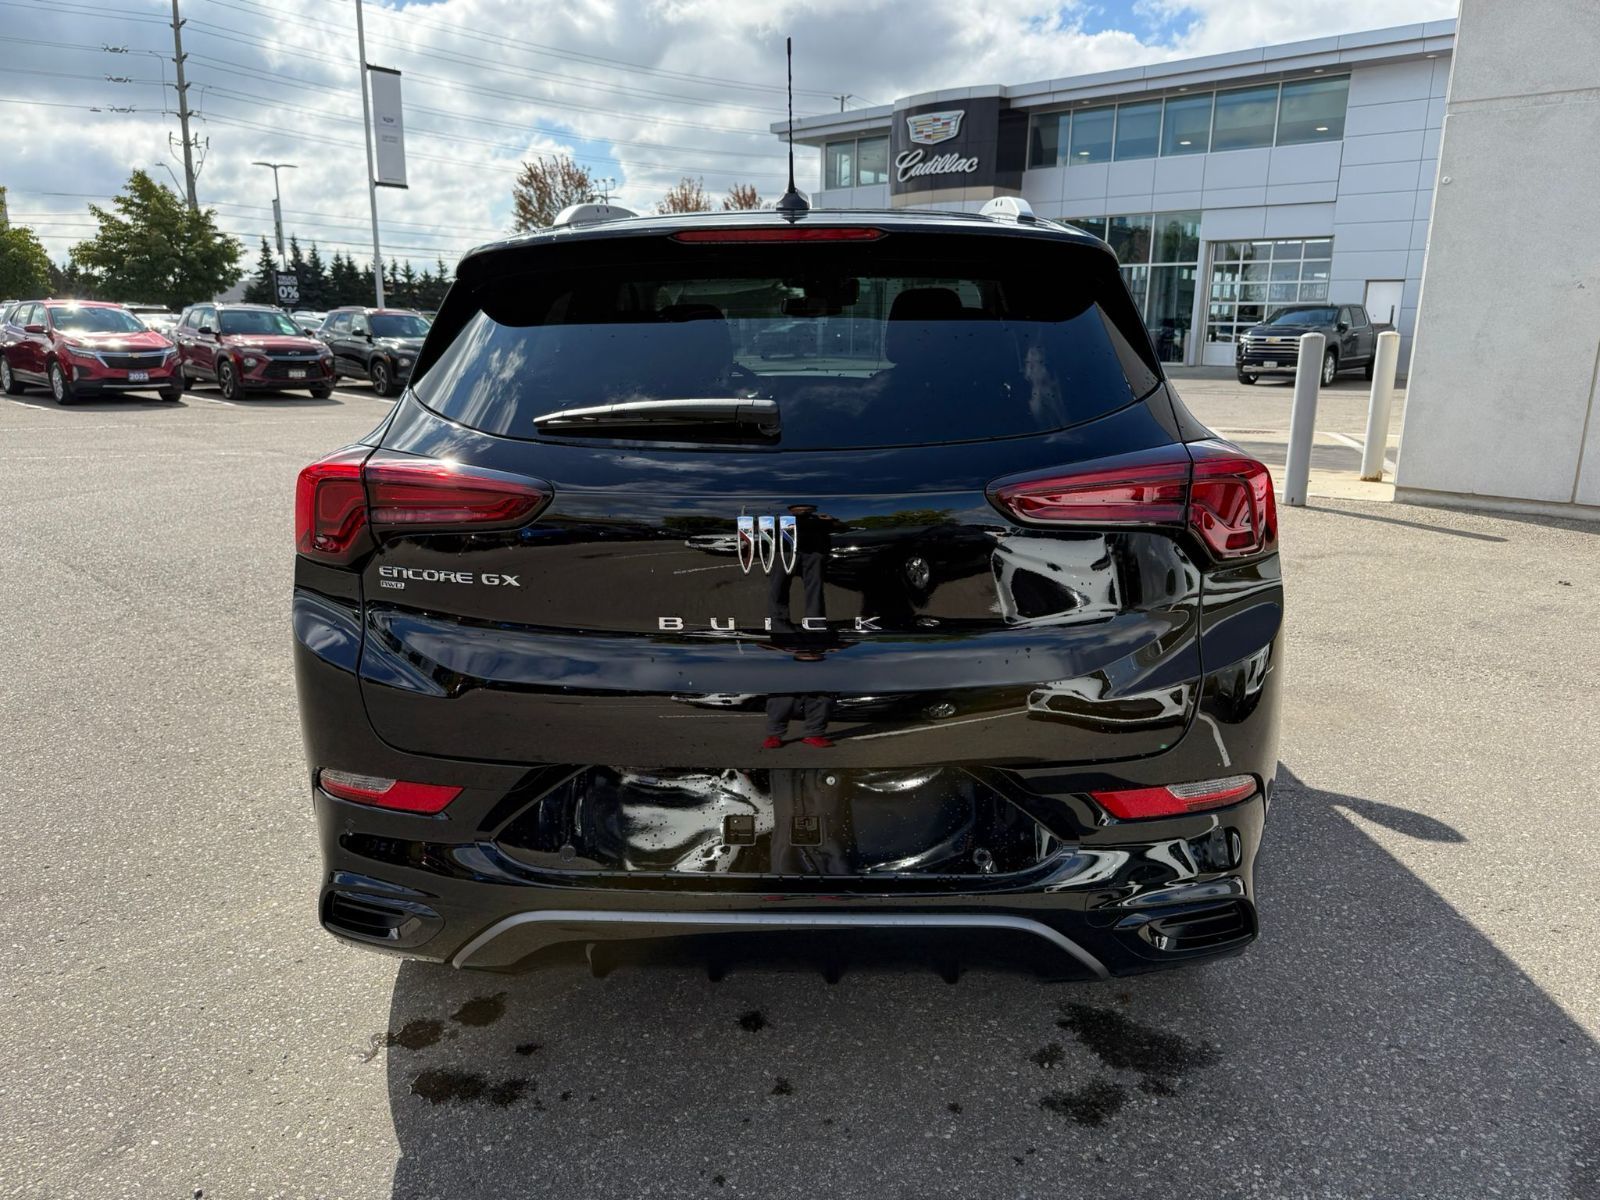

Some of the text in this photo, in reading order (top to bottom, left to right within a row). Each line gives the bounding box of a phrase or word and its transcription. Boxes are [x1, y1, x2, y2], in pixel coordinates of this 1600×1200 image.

[895, 149, 978, 182] Cadillac
[279, 286, 300, 298] 0%
[378, 565, 521, 587] ENCORE GX
[381, 580, 405, 590] AWD
[657, 616, 883, 631] BUICK
